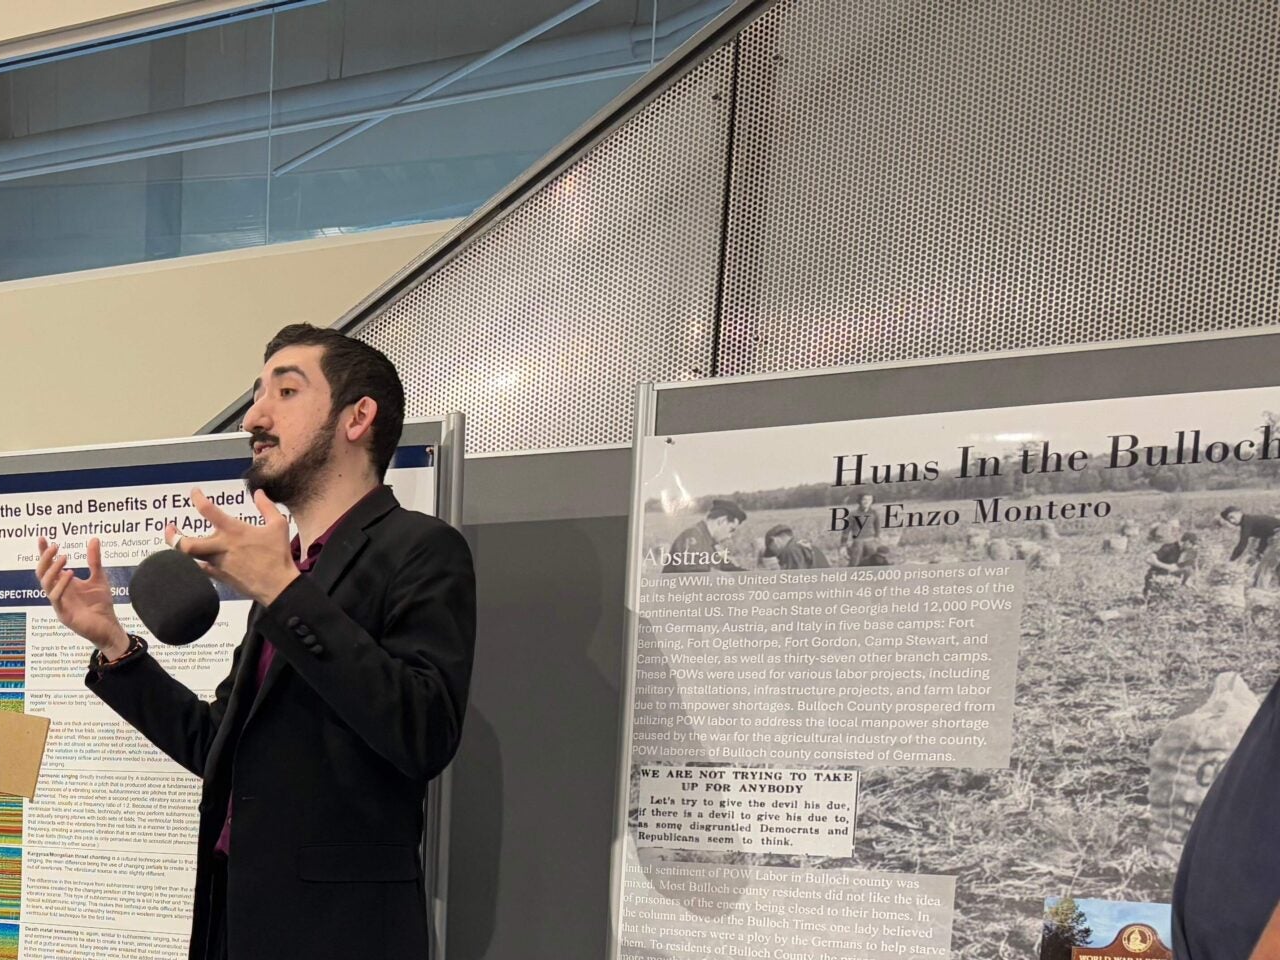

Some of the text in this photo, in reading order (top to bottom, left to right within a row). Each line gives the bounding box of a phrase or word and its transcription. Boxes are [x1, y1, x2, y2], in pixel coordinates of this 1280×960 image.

[831, 453, 939, 488] Huns
[954, 445, 1000, 480] In
[1020, 440, 1088, 475] the
[0, 504, 21, 517] the
[26, 502, 52, 516] Use
[57, 500, 83, 515] and
[88, 497, 147, 513] Benefits
[153, 495, 167, 509] of
[173, 491, 244, 508] Exnded
[828, 497, 1111, 538] By Enzo Montero
[63, 519, 140, 536] Ventricular
[63, 540, 83, 549] Jason
[86, 538, 119, 548] Lbros,
[17, 554, 34, 562] Fred
[104, 551, 129, 559] School
[132, 550, 139, 558] of
[643, 546, 730, 566] Abstract
[641, 566, 1010, 588] During WWII, the United States held 425,000 prisoners of war
[0, 589, 46, 599] SPECTROG
[640, 582, 1014, 604] at its height across 700 camps within 46 of the 48 states of the
[639, 600, 1012, 618] continental US. The Peach State of Georgia held 12,000 POWs
[641, 769, 853, 782] WE ARE NOT TRYING TO TAKE
[682, 783, 803, 793] UP FOR ANYBODY
[650, 796, 850, 811] Let's try to give the devil his due,
[639, 808, 649, 817] if
[652, 809, 678, 818] there
[709, 811, 734, 819] devil
[741, 812, 750, 820] to
[757, 813, 780, 822] give
[786, 813, 802, 822] his
[808, 814, 828, 822] due
[835, 815, 849, 824] to,
[690, 821, 751, 833] disgruntled
[760, 824, 819, 835] Democrats
[828, 827, 848, 835] and
[639, 833, 699, 843] Republicans
[743, 837, 752, 845] to
[762, 838, 792, 847] think.
[625, 864, 920, 890] Initial sentiment of POW Labor in Bulloch county was
